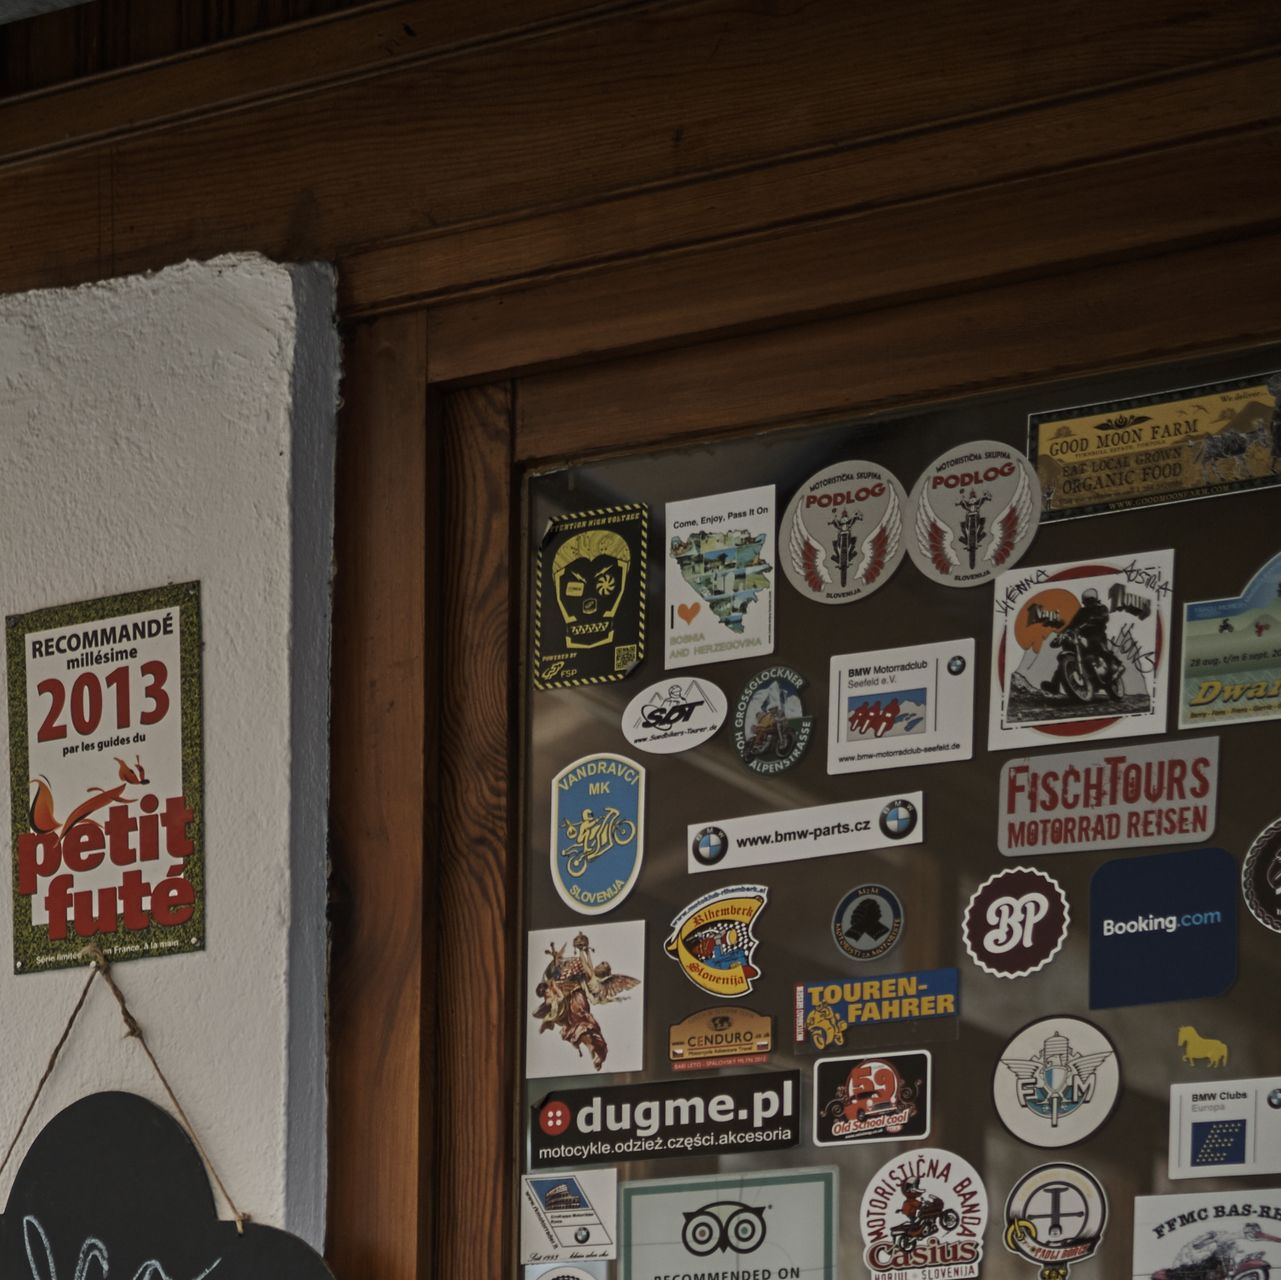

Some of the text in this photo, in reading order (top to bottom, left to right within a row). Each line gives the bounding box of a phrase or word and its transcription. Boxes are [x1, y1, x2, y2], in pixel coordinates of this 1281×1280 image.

[1050, 419, 1199, 456] GOOD MOON FARM
[984, 451, 1012, 461] SKUPINA
[1092, 458, 1131, 474] LOCAL
[1135, 447, 1183, 464] GROWN
[856, 471, 882, 481] SKUPINA
[932, 462, 1016, 490] PODLOG
[1062, 470, 1136, 495] ORGANIC
[1142, 463, 1183, 483] FOOD
[805, 482, 887, 508] PODLOG
[673, 505, 769, 530] Come, Enjoy, Pass It On
[954, 569, 991, 582] SLOVENIJA
[825, 588, 861, 600] SLOVENIJA
[670, 603, 675, 630] I
[31, 612, 175, 660] RECOMMANDÉ
[669, 637, 762, 659] AND HERZEGOVINA
[65, 645, 139, 671] millésime
[848, 660, 928, 678] BMW Motorradclub
[1223, 653, 1240, 664] t/m
[848, 677, 879, 689] Seefeld
[36, 658, 171, 744] 2013
[734, 668, 805, 728] GROSSGLOCKNER
[62, 732, 147, 758] par les guides du
[838, 742, 961, 763] www.bmw-motorradclub-seefeld.de
[588, 781, 611, 796] MK
[736, 819, 872, 848] www.bmw-parts.cz
[1007, 805, 1208, 849] MOTORRAD REISEN
[18, 793, 195, 896] petit
[44, 863, 196, 942] futé
[569, 878, 625, 904] SLOVENIJA
[982, 891, 1050, 955] BP
[1102, 909, 1222, 937] Booking.com
[150, 941, 159, 950] la
[685, 962, 744, 987] Slovenija
[807, 976, 928, 1006] TOUREN-
[847, 993, 956, 1024] FAHRER
[687, 1031, 754, 1048] CENDURO
[851, 1066, 895, 1099] 59
[576, 1079, 794, 1138] dugme.pl
[1191, 1090, 1248, 1102] BMW Clubs
[1191, 1103, 1226, 1113] Europa
[833, 1122, 851, 1135] Old
[852, 1115, 886, 1131] School
[886, 1109, 909, 1125] cool
[538, 1127, 793, 1161] motocykle.odzież.części.akcesoria
[866, 1154, 982, 1244] MOTORISTIČNA BANDA
[1152, 1208, 1208, 1239] FFMC
[868, 1237, 980, 1271] Casius
[777, 1266, 801, 1280] ON
[921, 1265, 976, 1280] SLOVENIJA
